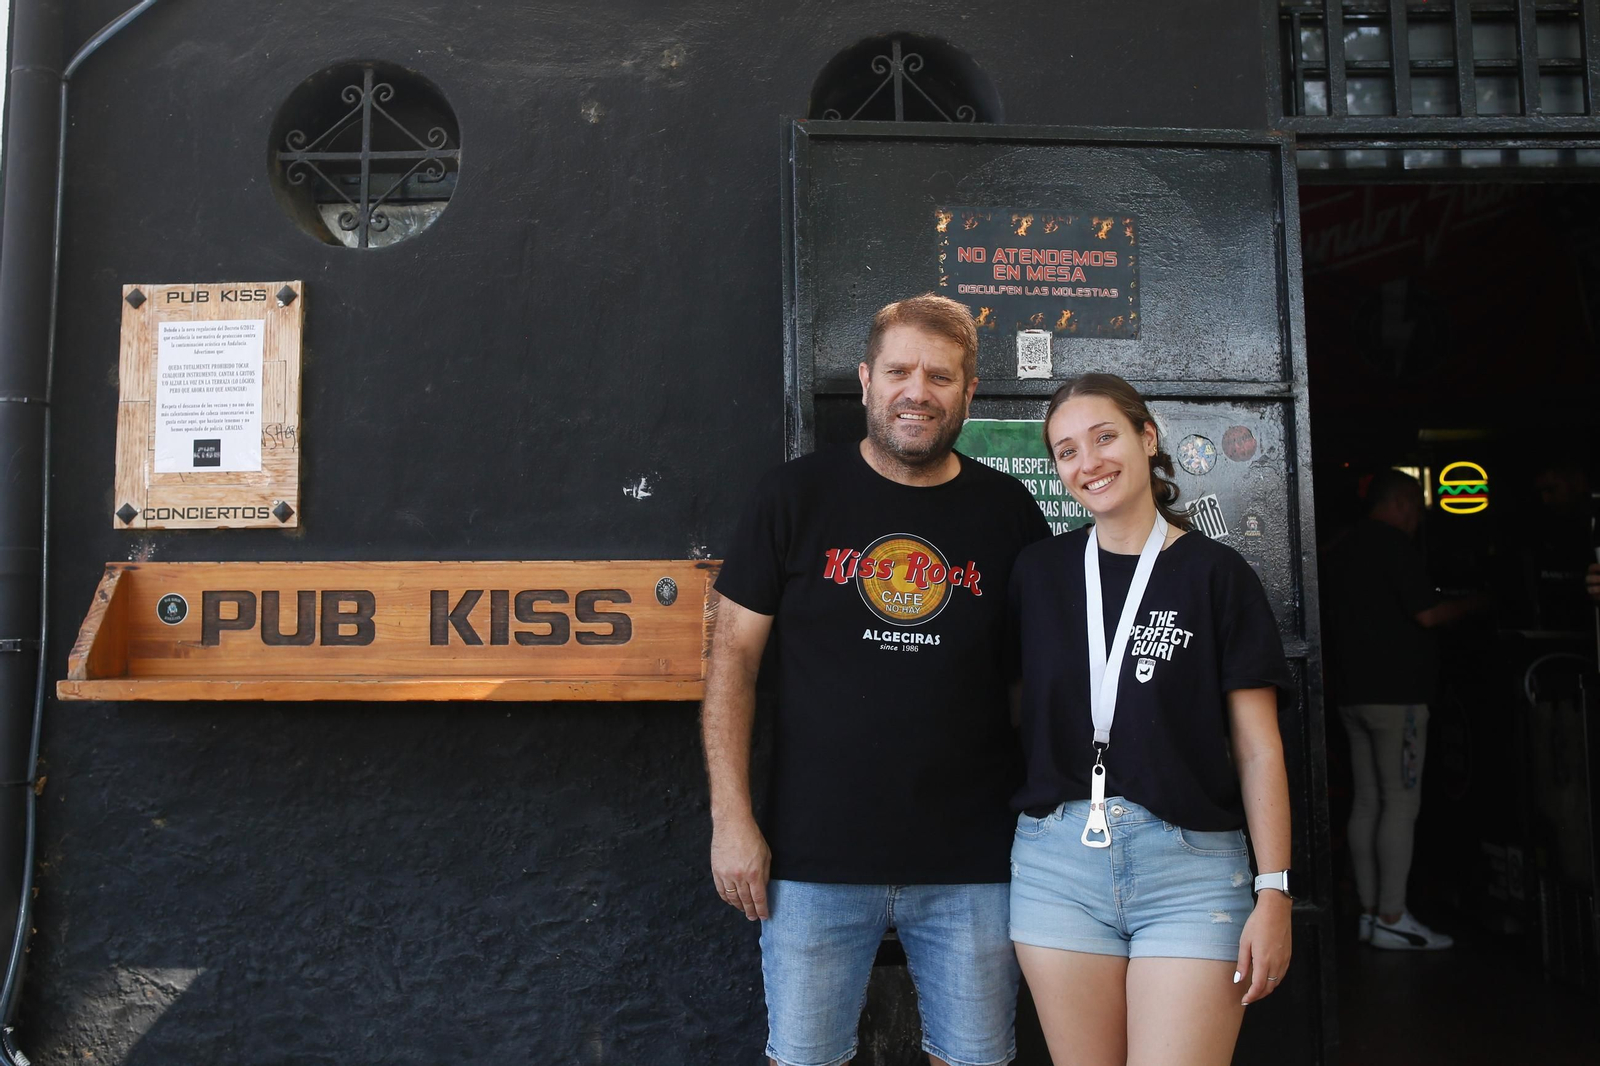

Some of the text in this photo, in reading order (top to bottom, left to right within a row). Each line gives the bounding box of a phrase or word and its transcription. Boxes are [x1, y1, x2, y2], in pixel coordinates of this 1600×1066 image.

[957, 246, 1118, 267] NO ATENDEMOS
[993, 264, 1086, 282] EN MESA
[166, 289, 267, 304] PUB KISS
[958, 284, 1119, 298] DISCULPEN LAS MOLESTIAS
[1039, 479, 1046, 495] Y
[1049, 479, 1063, 496] NO
[142, 506, 270, 521] CONCIERTOS
[823, 548, 983, 596] Kiss Rock
[881, 590, 923, 606] CAFE
[201, 588, 633, 647] PUB KISS
[885, 604, 922, 614] NO HAY
[1149, 610, 1178, 627] THE
[862, 629, 941, 646] ALGECIRAS
[1131, 640, 1175, 661] GUIRI
